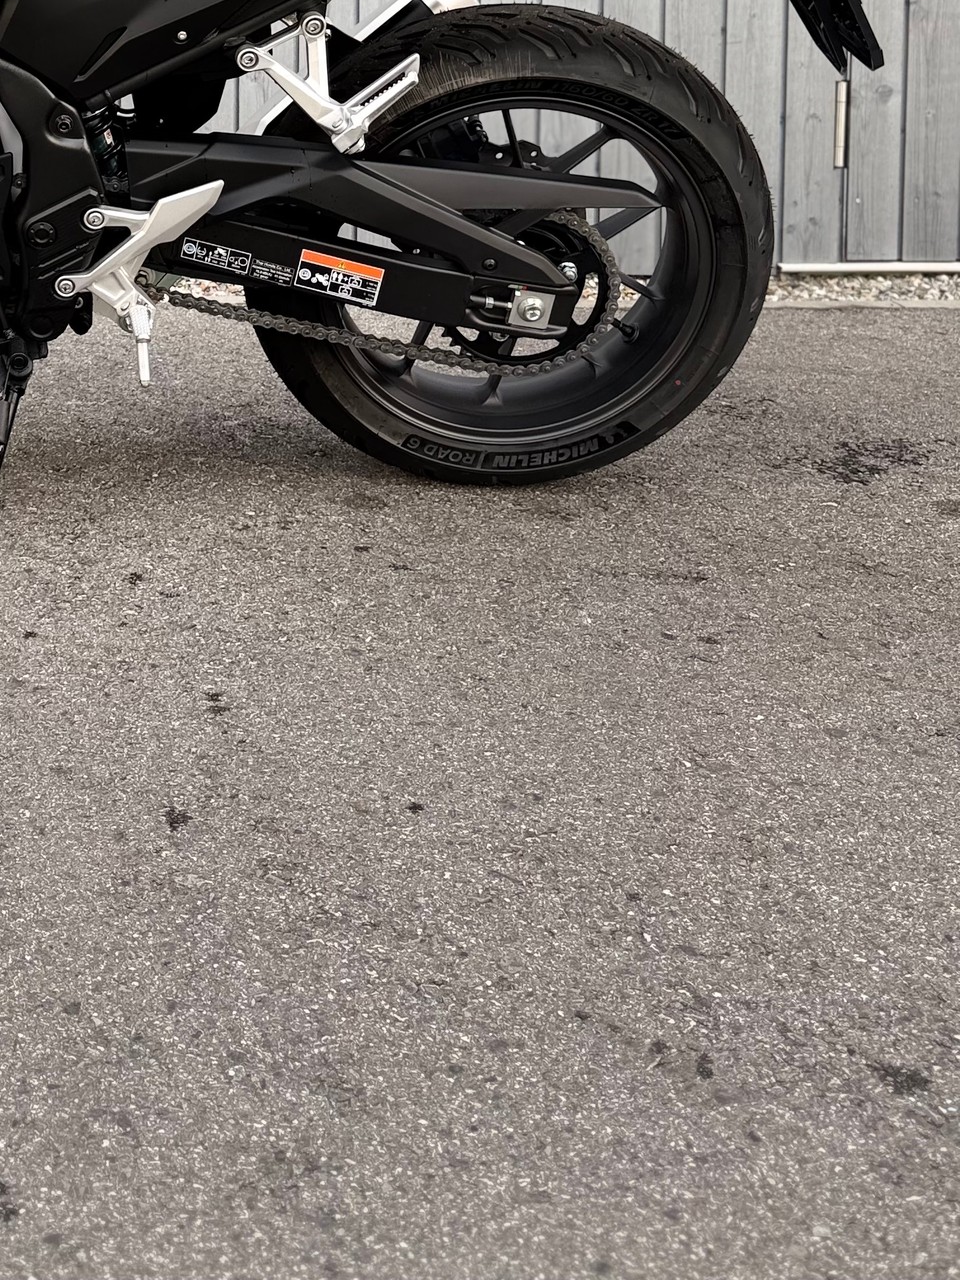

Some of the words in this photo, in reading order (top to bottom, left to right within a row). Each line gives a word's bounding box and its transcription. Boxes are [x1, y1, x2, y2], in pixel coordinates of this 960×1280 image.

[406, 437, 420, 449] 6
[423, 443, 476, 465] ROAD
[492, 437, 599, 468] MICHELIN
